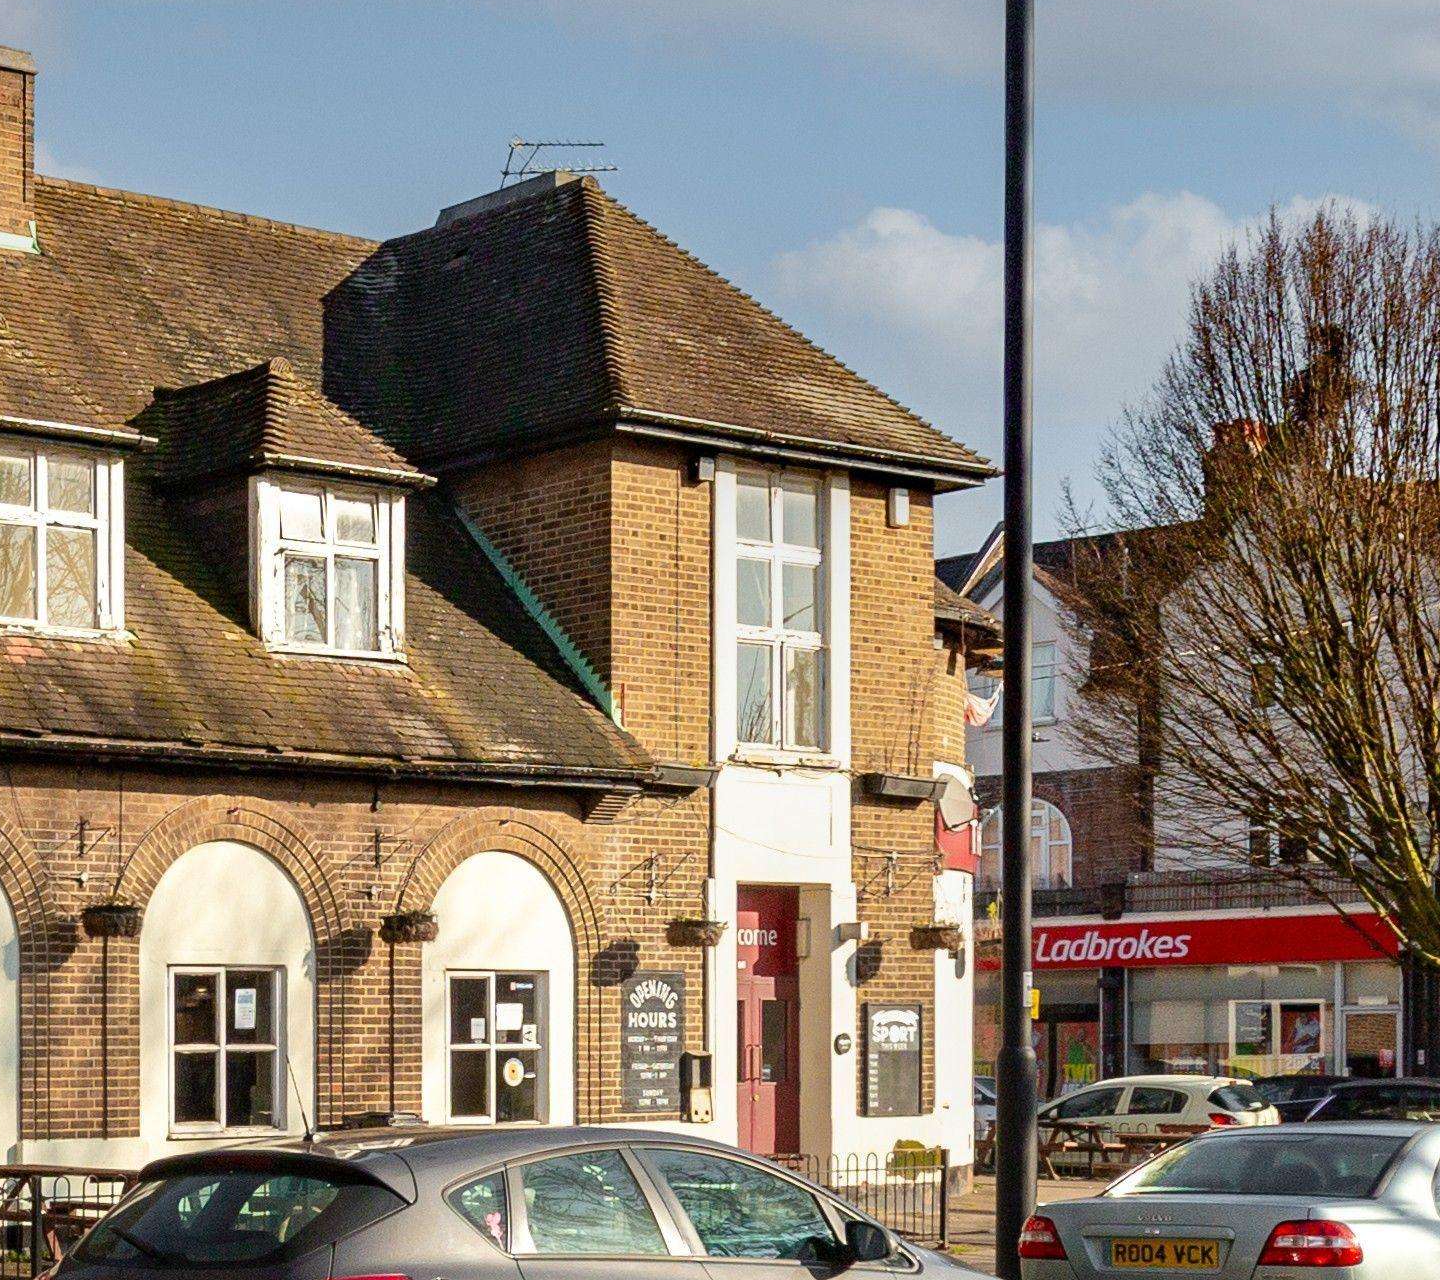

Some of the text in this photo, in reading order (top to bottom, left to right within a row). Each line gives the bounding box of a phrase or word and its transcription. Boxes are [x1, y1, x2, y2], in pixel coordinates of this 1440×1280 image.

[737, 928, 778, 946] come
[1034, 928, 1192, 963] Ladbrokes
[629, 979, 679, 1010] OPENING
[627, 1011, 677, 1029] HOURS
[871, 1024, 917, 1043] SPORT
[1173, 1243, 1214, 1265] VCK
